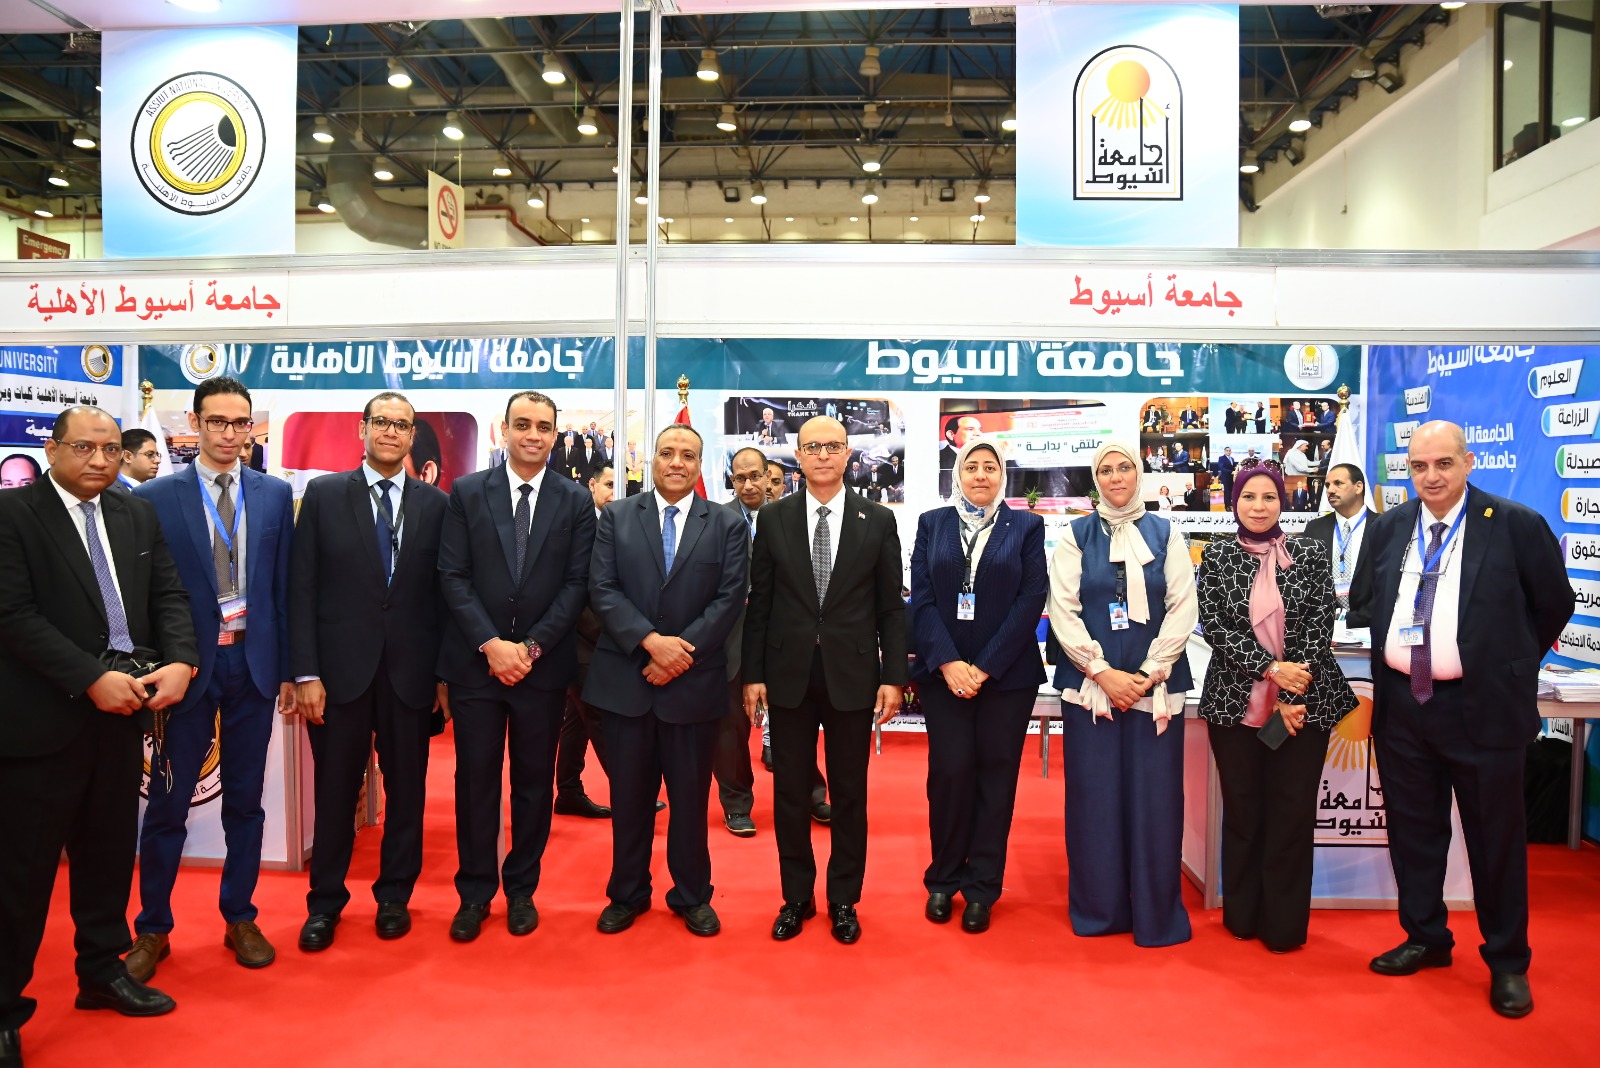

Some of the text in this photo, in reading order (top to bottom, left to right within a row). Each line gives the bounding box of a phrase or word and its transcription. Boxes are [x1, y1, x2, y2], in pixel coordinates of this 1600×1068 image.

[145, 90, 169, 118] ASSIUT
[22, 234, 67, 258] Emergency
[27, 280, 281, 322] جامعة أسيوط الأهلية
[1069, 273, 1243, 317] جامعة أسيوط
[489, 342, 585, 380] جامعة
[1036, 342, 1185, 386] جامعة
[1540, 367, 1572, 389] العلوم
[1558, 407, 1589, 428] الزراعة
[1475, 422, 1514, 446] الجامعة
[1480, 450, 1517, 473] جامعات
